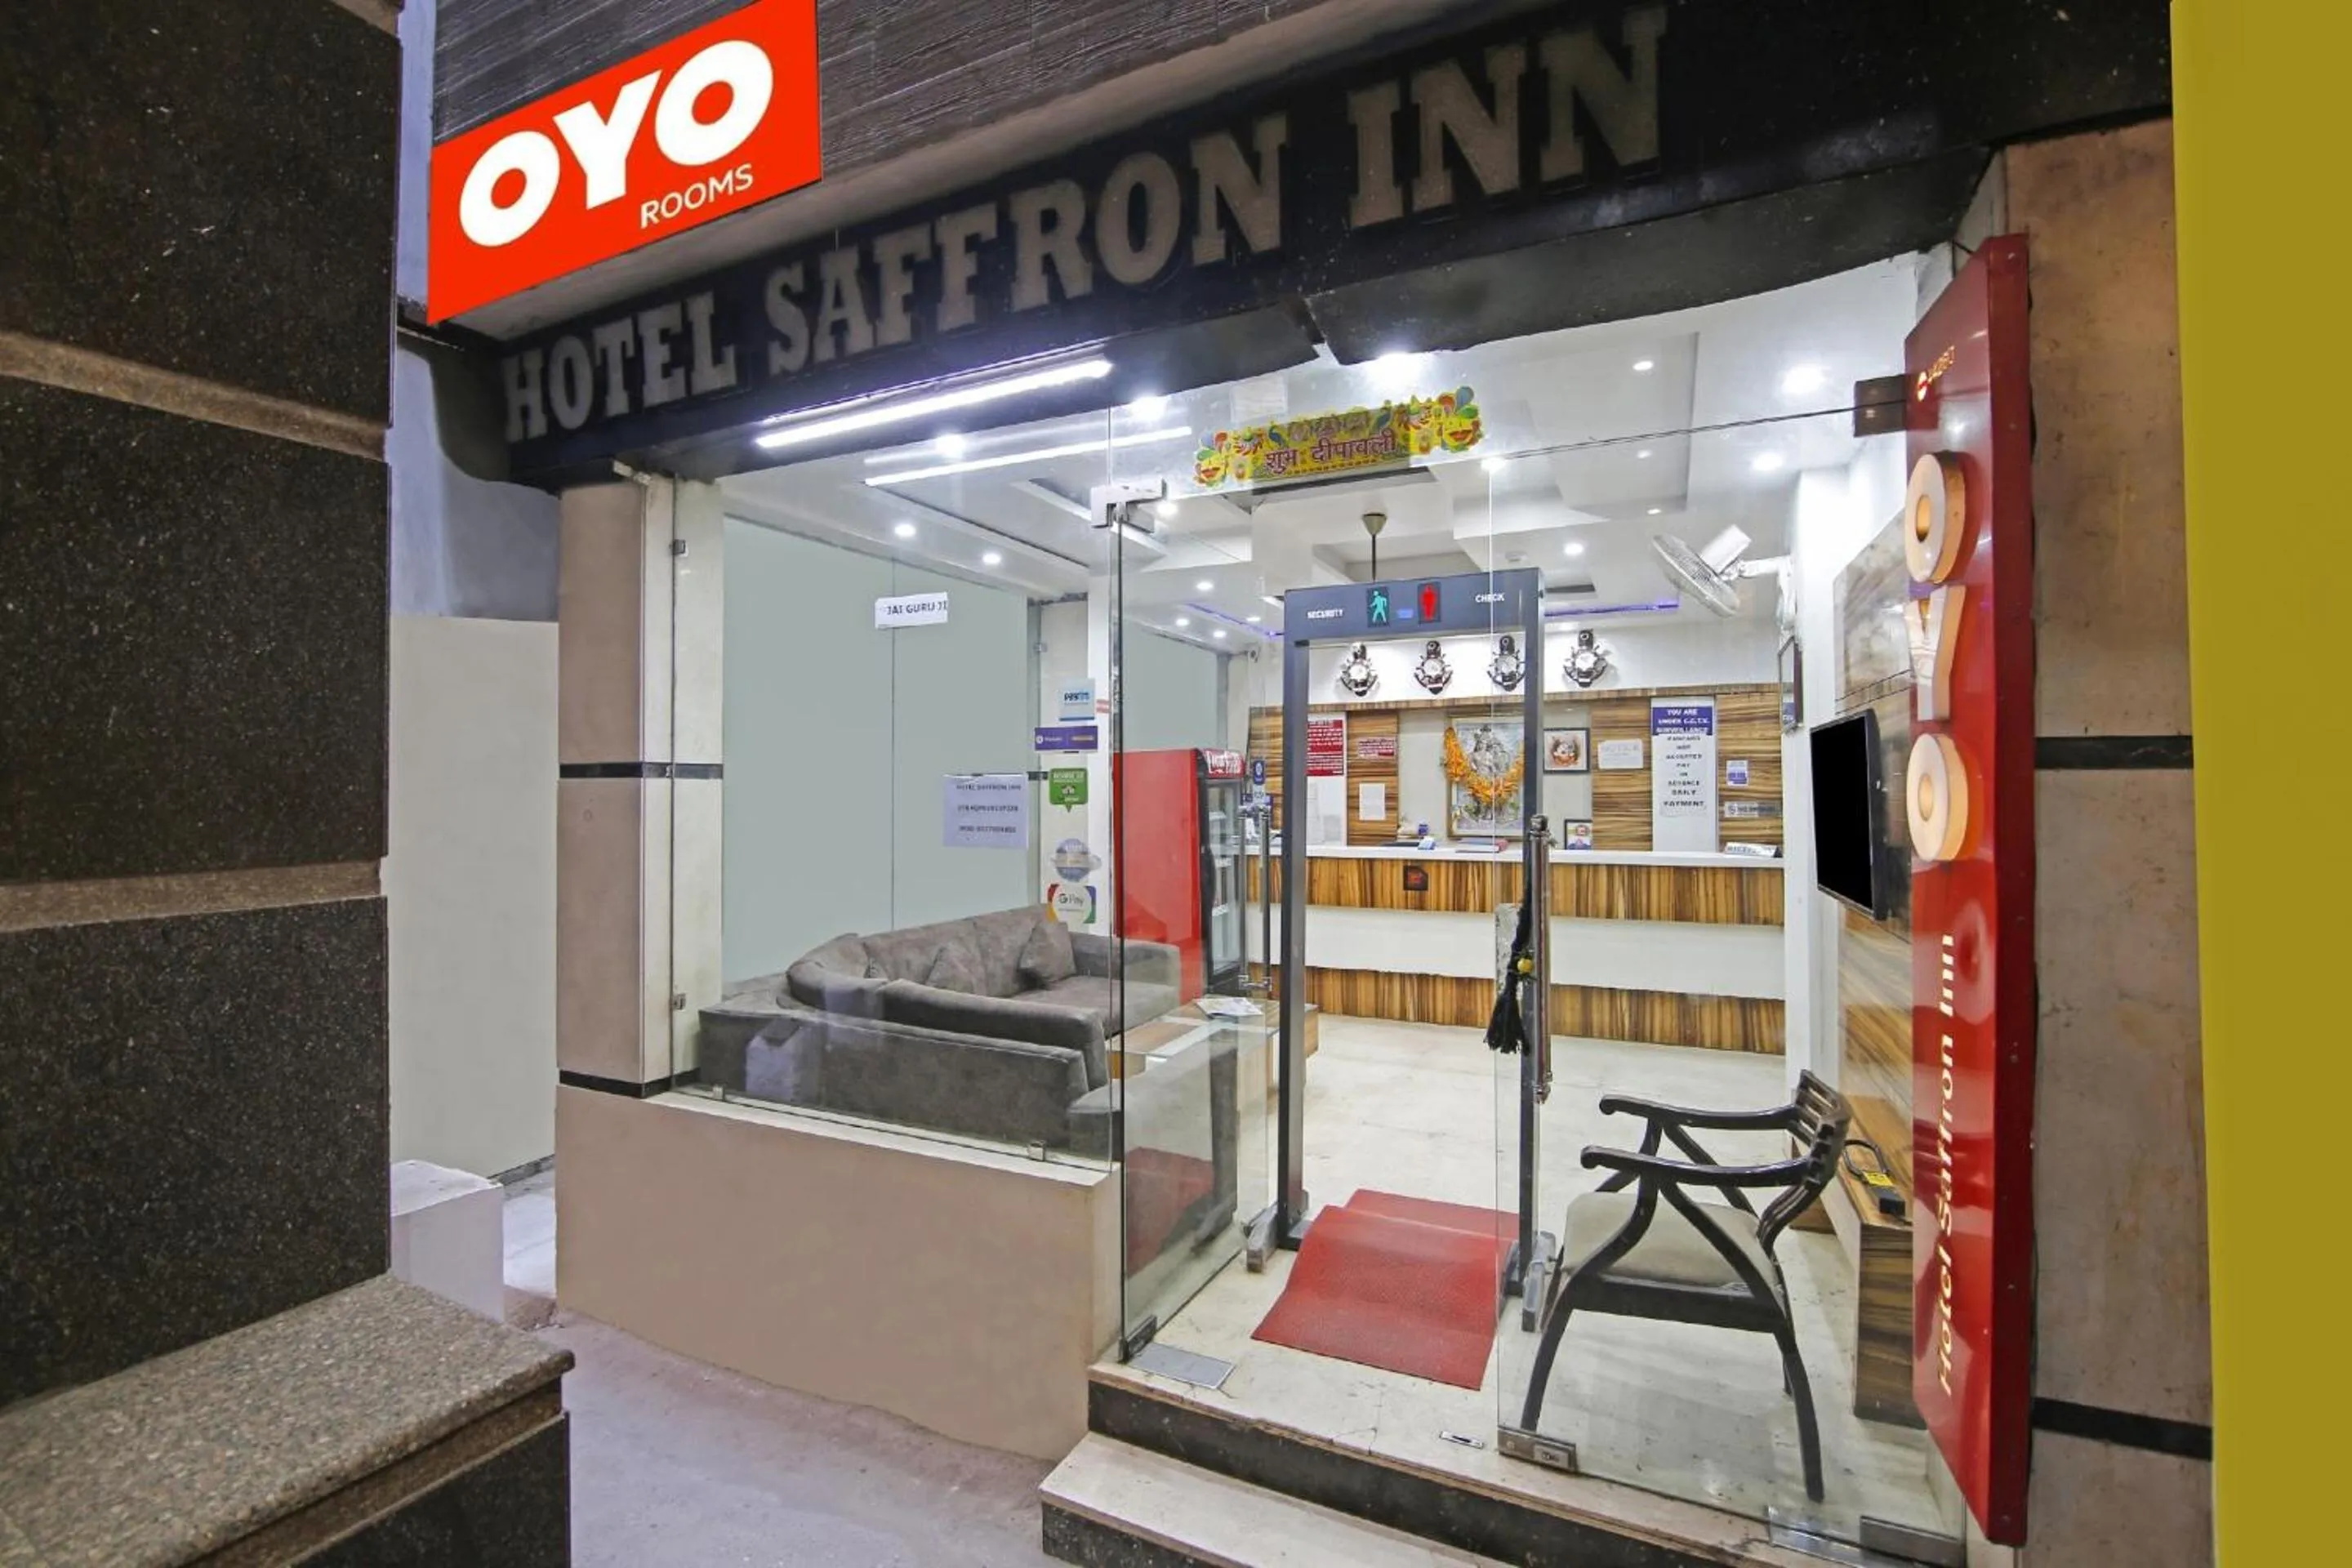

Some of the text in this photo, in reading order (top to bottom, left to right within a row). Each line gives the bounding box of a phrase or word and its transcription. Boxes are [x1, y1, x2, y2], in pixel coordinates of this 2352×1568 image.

[459, 40, 774, 247] OYO
[502, 7, 1668, 444] HOTEL SAFFRON INN
[639, 164, 754, 229] ROOMS
[1266, 448, 1300, 475] शुभ
[906, 601, 936, 614] GURU
[1904, 452, 1967, 862] OYO
[1935, 933, 1954, 1397] Hotel Saffron Inn
